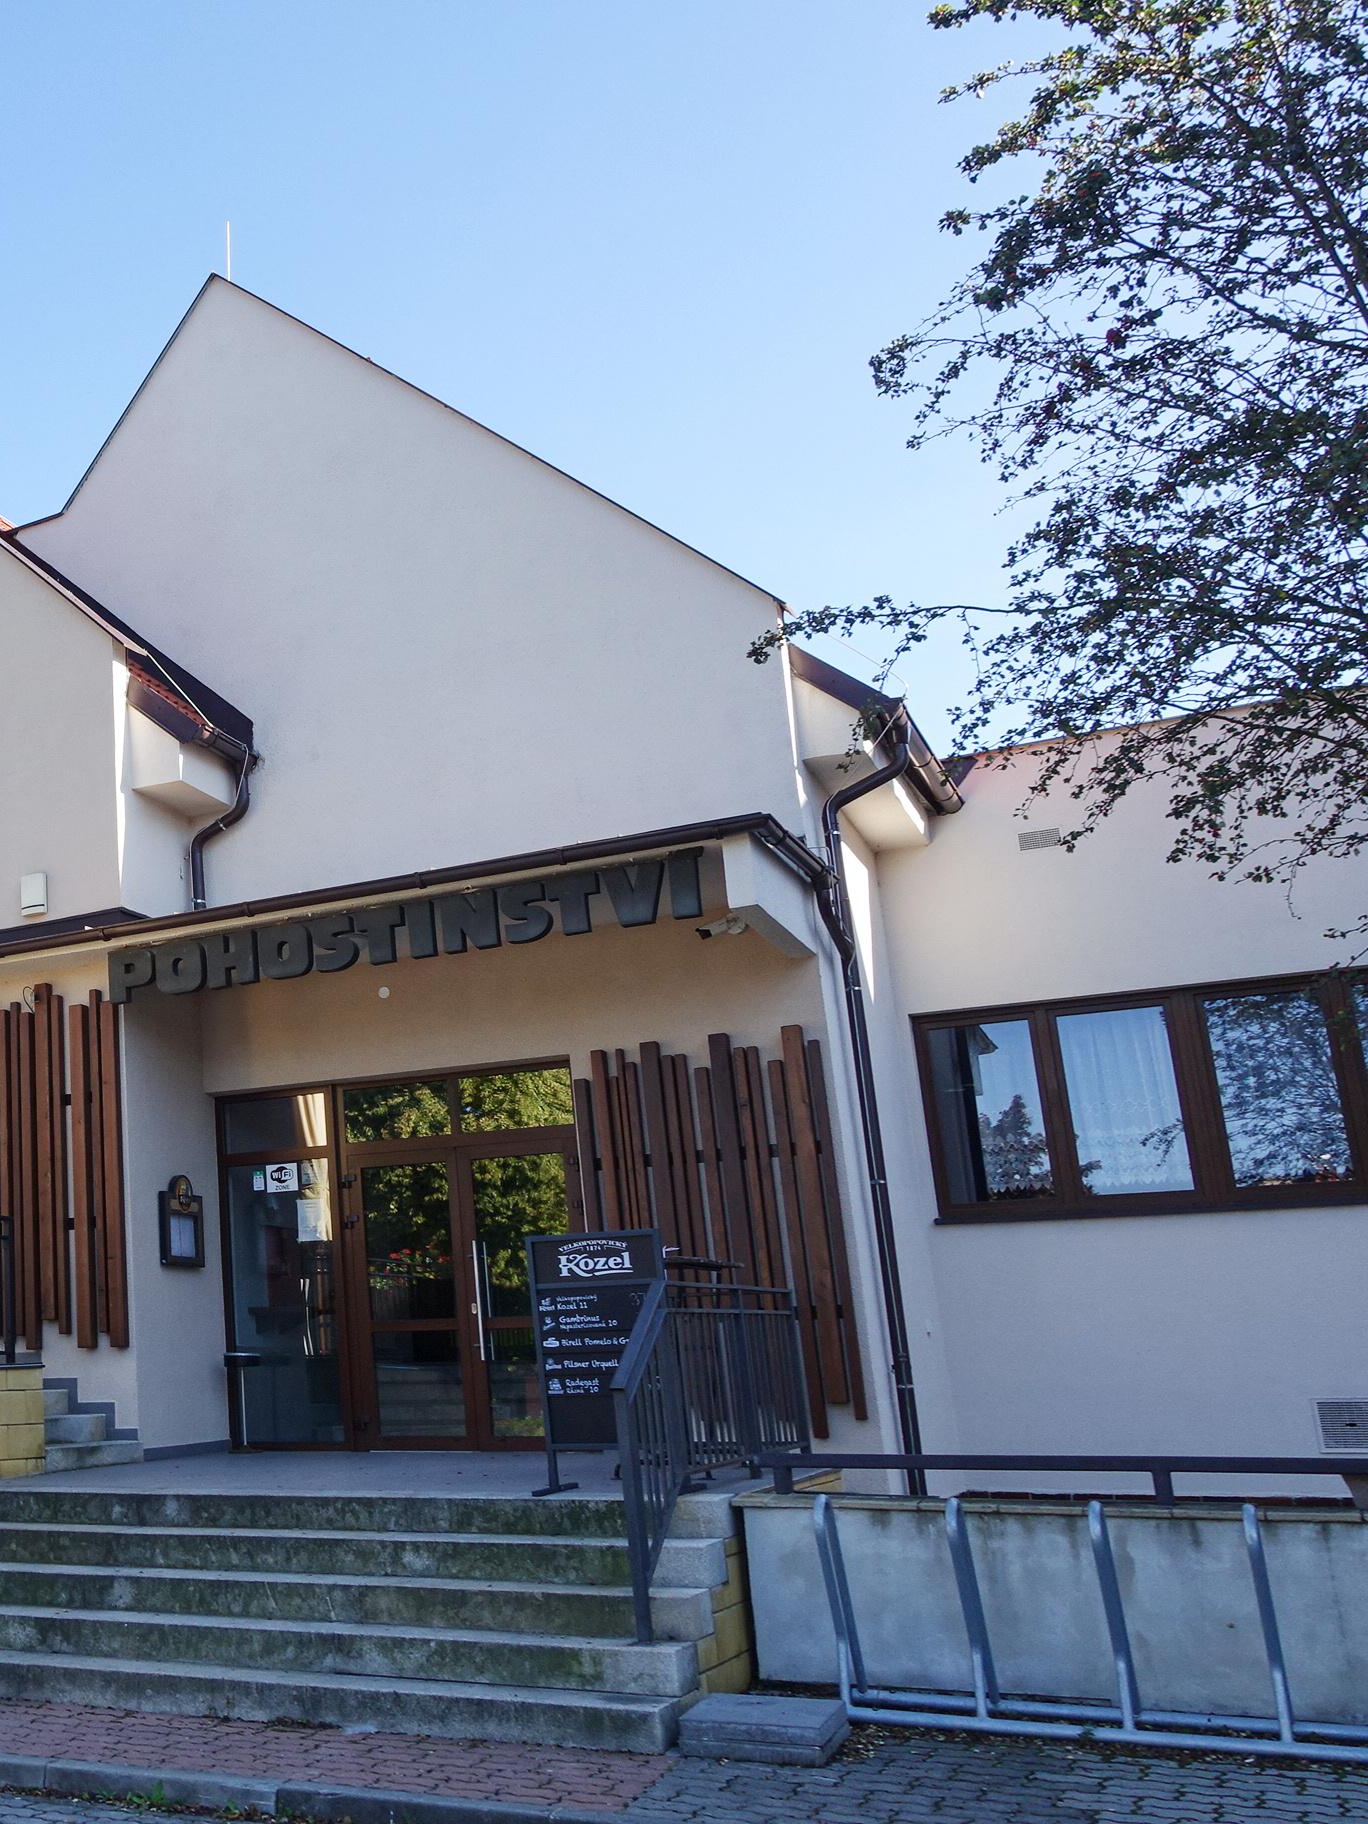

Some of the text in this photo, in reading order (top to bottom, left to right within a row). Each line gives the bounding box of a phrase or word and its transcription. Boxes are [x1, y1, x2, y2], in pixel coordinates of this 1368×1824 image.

[557, 1251, 633, 1277] Kozel
[557, 1302, 577, 1310] Kozel
[558, 1314, 600, 1323] Gambrinus
[584, 1337, 612, 1346] Pomelo
[563, 1359, 619, 1371] Pilsner Urquell
[565, 1378, 600, 1388] Radegast
